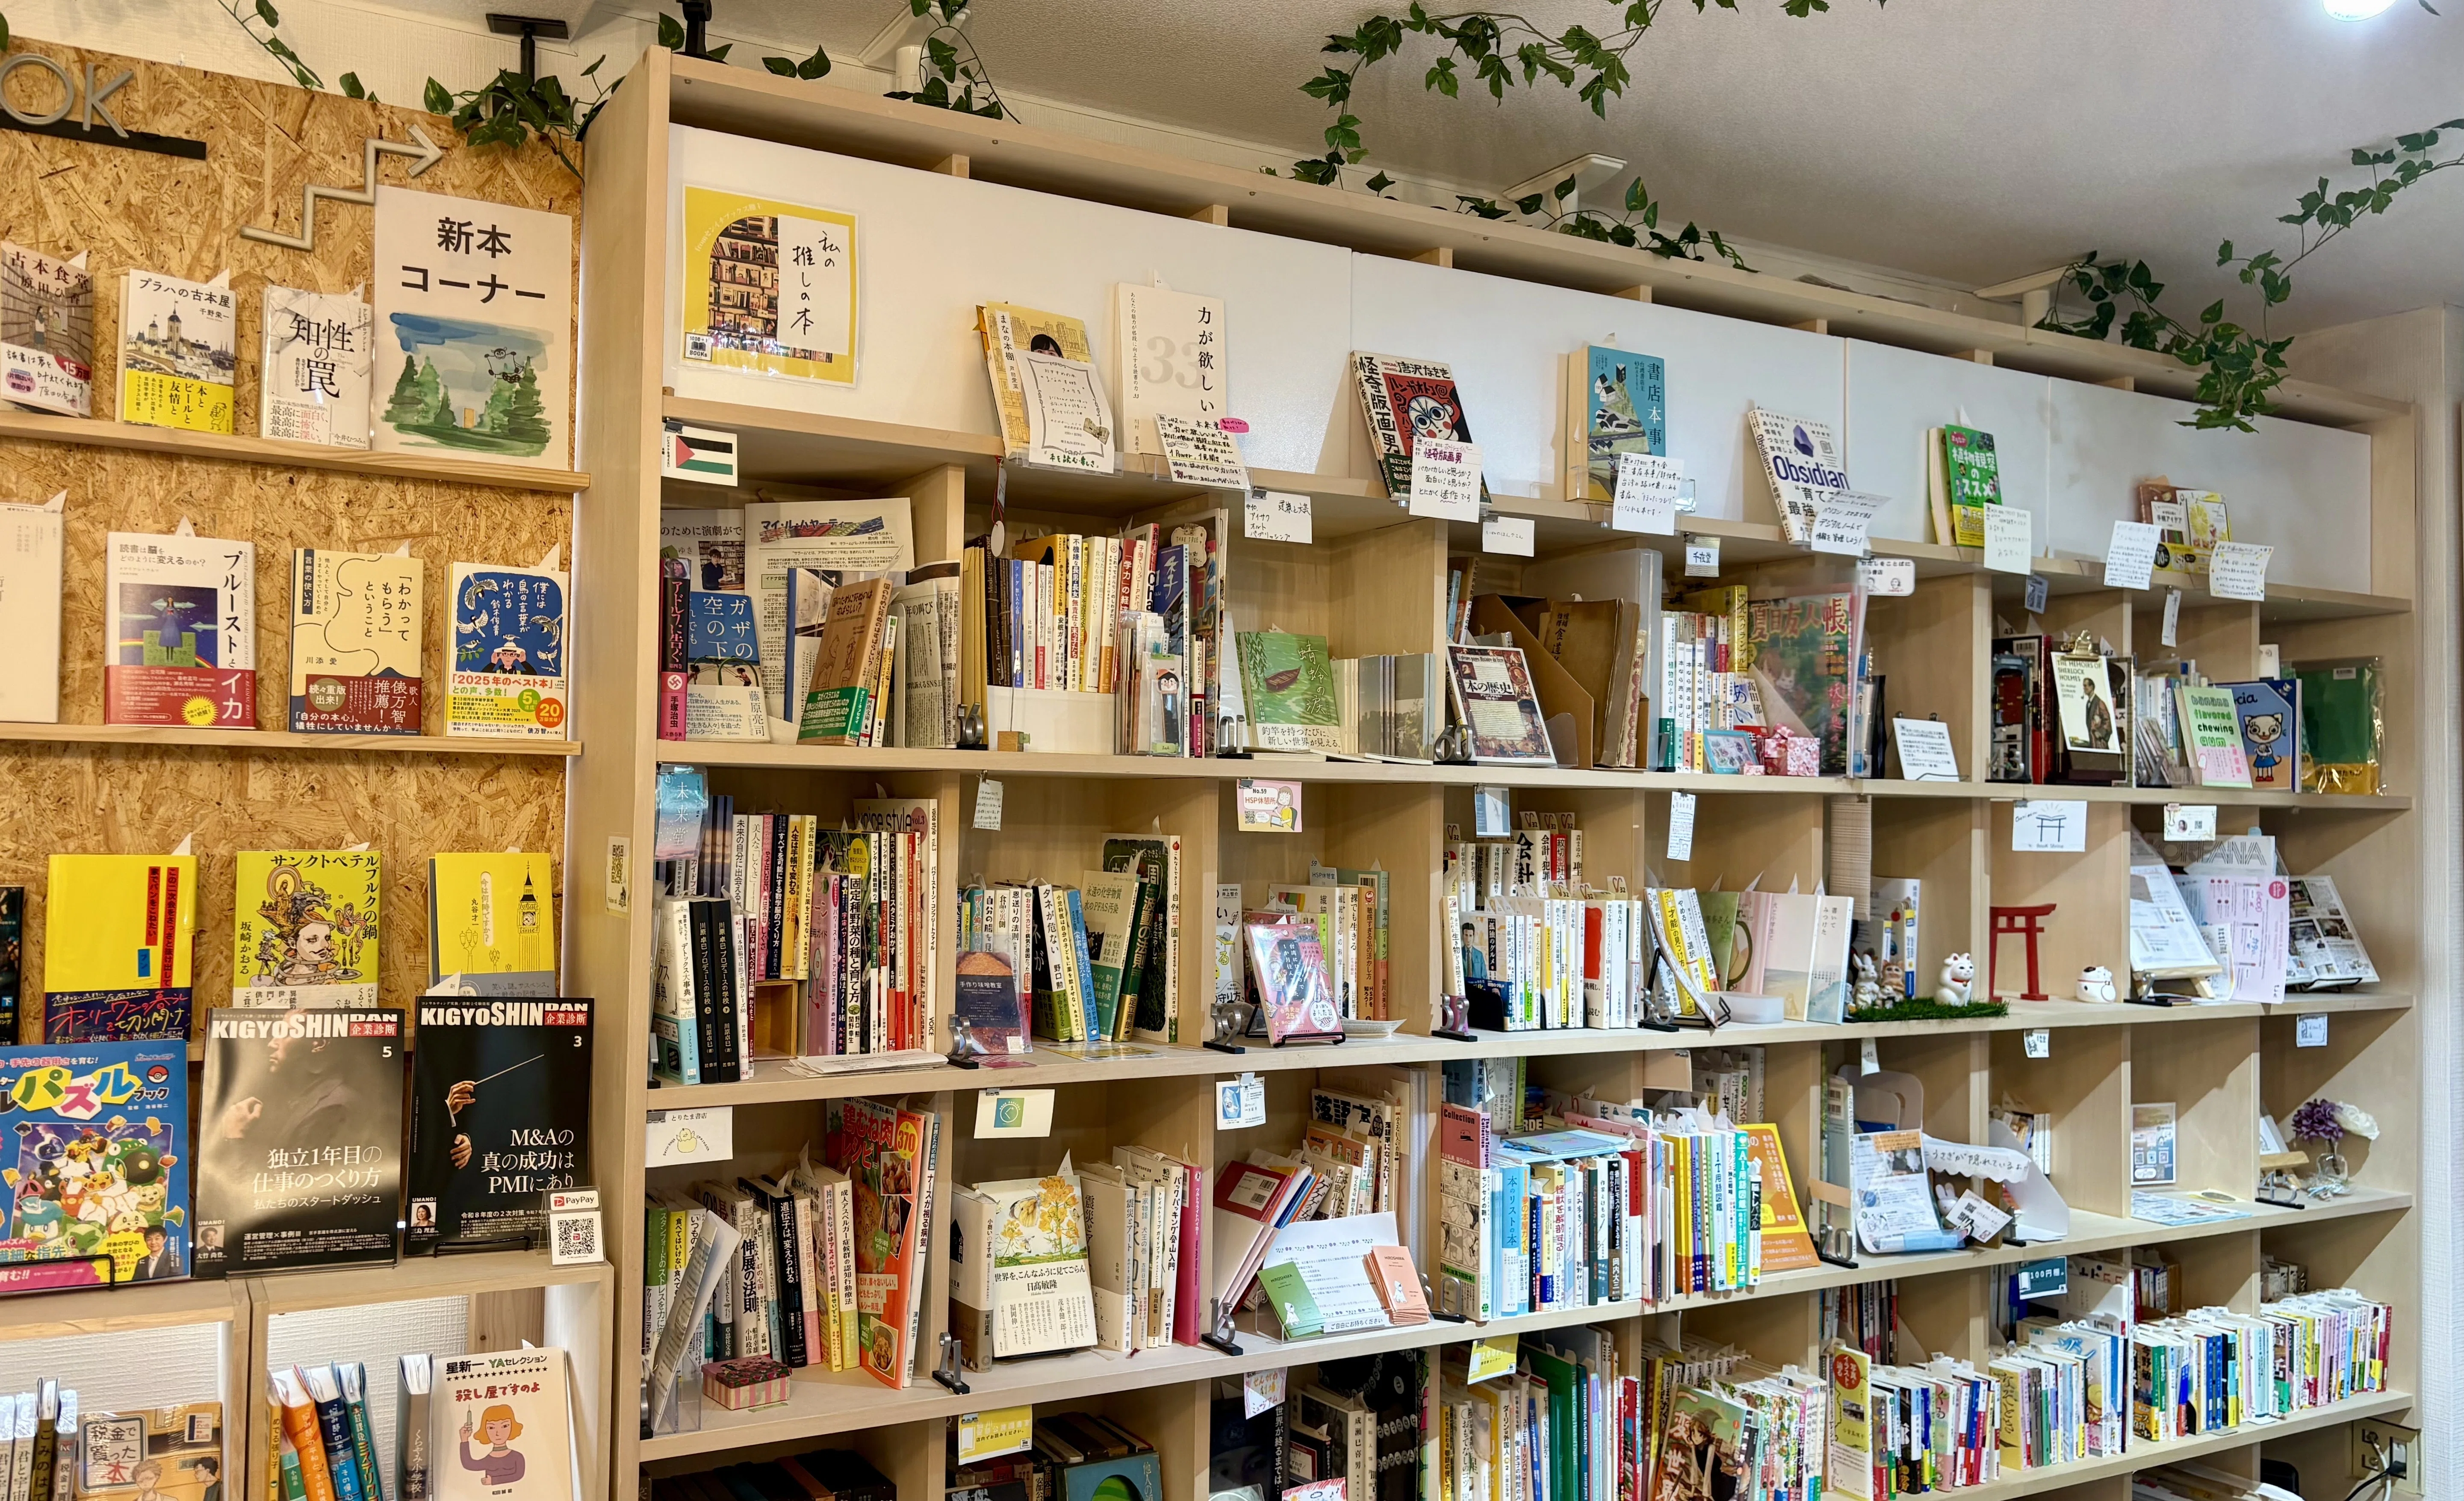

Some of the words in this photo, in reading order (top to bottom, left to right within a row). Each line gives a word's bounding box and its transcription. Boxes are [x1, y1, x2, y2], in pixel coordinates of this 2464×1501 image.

[437, 217, 511, 258] 新本
[818, 230, 841, 267] 私の
[10, 251, 89, 291] 古本食堂
[401, 266, 546, 303] コーナー
[21, 276, 80, 305] 原田ひ香
[139, 278, 230, 308] プラハの古本屋
[791, 245, 815, 335] 推しの本
[199, 307, 230, 320] 千野栄一
[1000, 314, 1015, 362] まなの本棚
[1141, 336, 1207, 390] 33
[1197, 306, 1215, 412] 力が欲しい
[1397, 360, 1451, 379] 唐沢なをき
[170, 381, 181, 415] 友情と
[183, 382, 193, 424] ビールと
[197, 385, 207, 408] 本と
[1358, 356, 1400, 455] 怪奇版画男
[1647, 363, 1661, 445] 書店本事
[270, 416, 318, 431] 最高に怖く、
[271, 405, 328, 423] 最高に面白く、
[270, 426, 322, 442] 最高に深い。
[1425, 447, 1462, 464] 怪奇版画男
[1952, 447, 1996, 471] 植物観察
[1773, 455, 1850, 490] Obsidian
[120, 544, 165, 555] 読書は脳を
[120, 555, 205, 567] どのように変えるのか?
[303, 556, 313, 607] 言葉の使い方
[502, 579, 513, 609] わかる
[378, 582, 393, 633] もらう」
[397, 575, 412, 641] 「わかって
[518, 579, 530, 633] 鳥の言葉が
[533, 582, 549, 609] 僕には
[364, 581, 374, 638] ということ
[490, 600, 500, 636] 鈴木俊貴
[670, 581, 684, 662] アドルフに告ぐ
[221, 551, 242, 719] プルーストとイカ
[702, 598, 729, 661] 空の下
[730, 598, 753, 659] ガザの
[329, 657, 337, 665] 愛
[309, 684, 346, 695] 続々重版
[453, 674, 553, 689] 「2025年のベスト本」
[453, 686, 507, 696] との声、多数!
[1467, 680, 1514, 695] 本の歴史
[316, 695, 339, 705] 出来!
[373, 680, 390, 723] 推薦!
[409, 686, 418, 706] 歌人
[296, 712, 359, 723] 「自分の本心」、
[540, 704, 560, 716] 20
[670, 696, 679, 728] 手塚治虫
[748, 691, 765, 736] 藤原亮司
[2195, 709, 2232, 721] flavored
[296, 722, 391, 732] 犠牲にしていませんか
[2198, 723, 2234, 735] chewing
[1245, 796, 1276, 805] HSP休憩所
[1541, 833, 1551, 882] 会計と犯罪
[481, 878, 490, 942] 今は何時ですか?
[1043, 888, 1059, 954] タネが危ない
[1349, 893, 1358, 951] 裸でも生きる
[849, 878, 861, 1003] 固定種野菜の種と育て方
[1133, 895, 1155, 970] 波動の法則
[240, 921, 252, 975] 坂崎かおる
[351, 1023, 396, 1037] 企業診断
[546, 1012, 587, 1025] 企業診断
[382, 1046, 392, 1058] 5
[573, 1036, 582, 1047] 3
[18, 1068, 137, 1114] パズル
[134, 1087, 168, 1100] ブック
[671, 1113, 708, 1121] とりたま書店
[842, 1107, 894, 1148] 鶏むね肉
[1443, 1111, 1475, 1124] Collection
[510, 1129, 575, 1147] M&Aの
[898, 1134, 916, 1152] 370
[266, 1145, 383, 1170] 独立1年目の
[481, 1150, 575, 1173] 真の成功は
[251, 1167, 383, 1194] 仕事のつくり方
[488, 1174, 574, 1194] PMIにあり
[254, 1194, 382, 1211] 私たちのスタートダッシュ
[566, 1196, 594, 1206] PayPay
[1507, 1176, 1517, 1246] 本のリストの本
[1126, 1198, 1134, 1252] 震災とアート
[994, 1265, 1086, 1282] 世界を、こんなふうに見てごらん
[1271, 1272, 1293, 1283] HIROSHIMA
[1330, 1317, 1383, 1330] ご自由にお持ちください
[446, 1360, 484, 1374] 星新一
[489, 1355, 547, 1368] YAセレクション
[456, 1382, 540, 1402] 殺し屋ですのよ
[411, 1429, 423, 1494] くらやみ小学校
